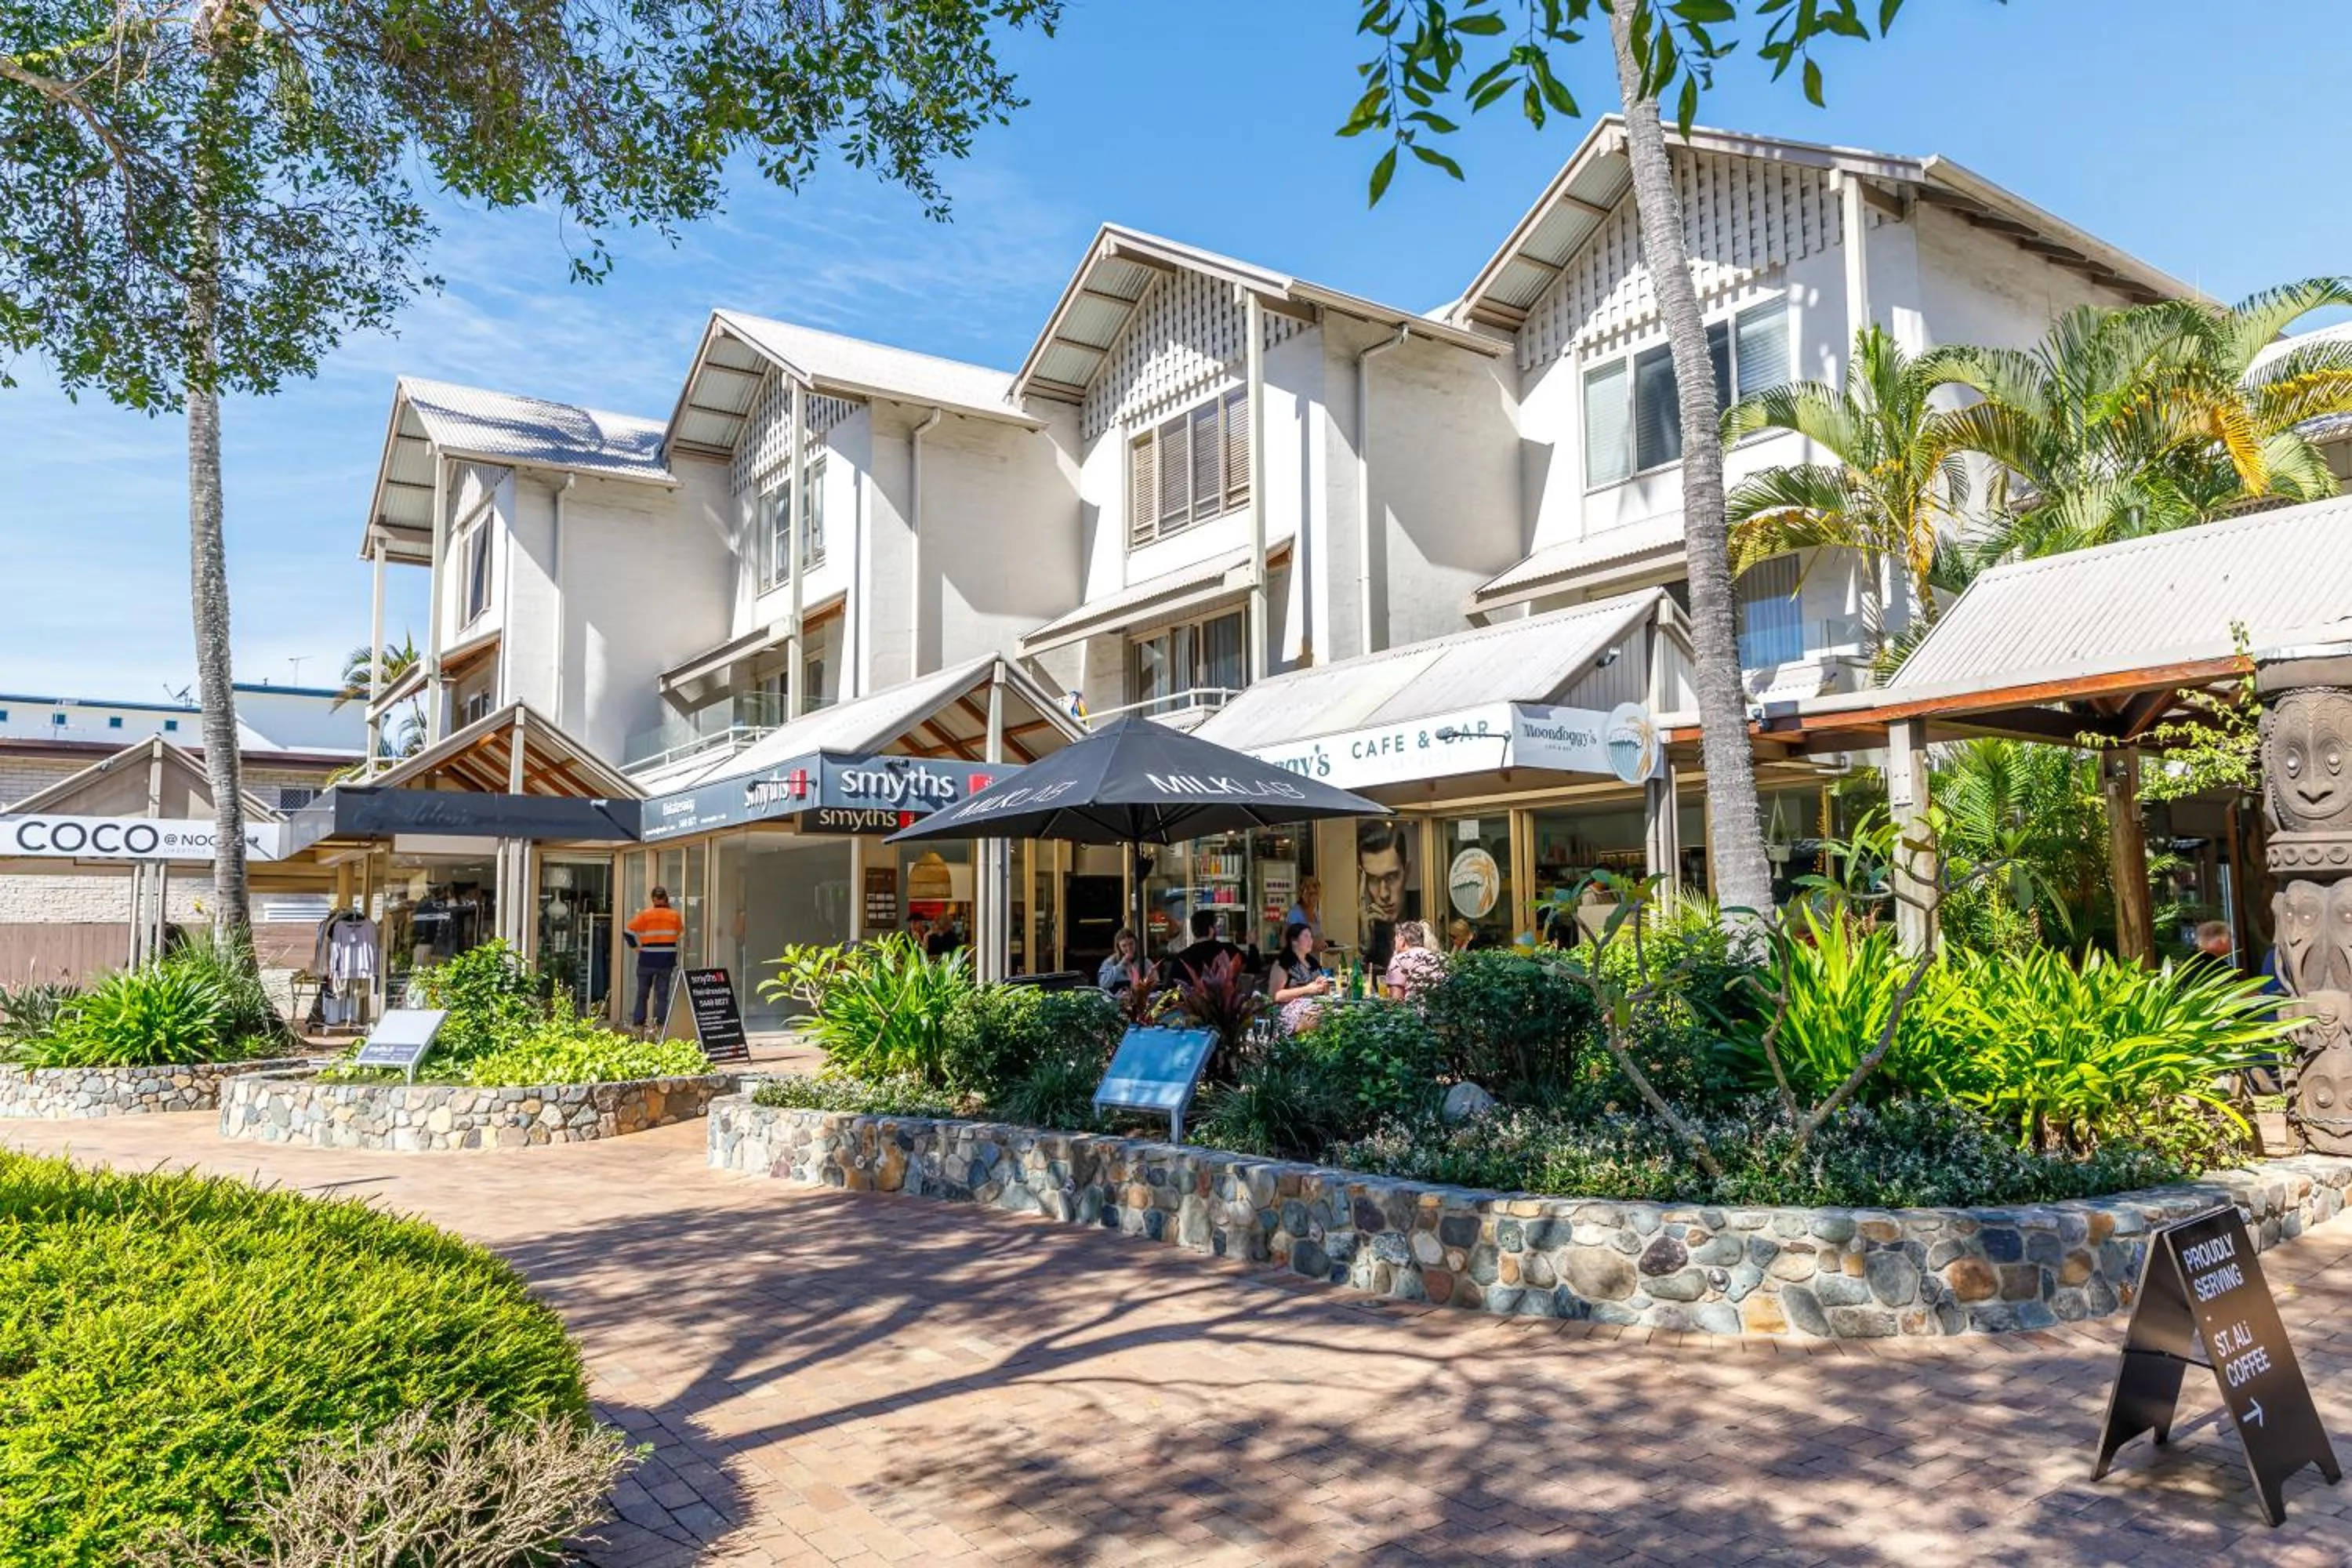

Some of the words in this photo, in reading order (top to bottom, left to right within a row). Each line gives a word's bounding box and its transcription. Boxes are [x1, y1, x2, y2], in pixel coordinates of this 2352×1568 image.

[1352, 735, 1405, 760] CAFE
[1417, 730, 1431, 749] &
[1523, 723, 1598, 747] Moondoggy's
[840, 765, 954, 803] smyths
[1145, 773, 1305, 800] MILKLAB
[819, 808, 897, 832] smyths
[16, 821, 159, 854] COCO
[164, 833, 178, 846] @
[2182, 1232, 2236, 1275] PROUDLY
[2194, 1262, 2244, 1302] SERVING
[2226, 1345, 2271, 1388] COFFEE
